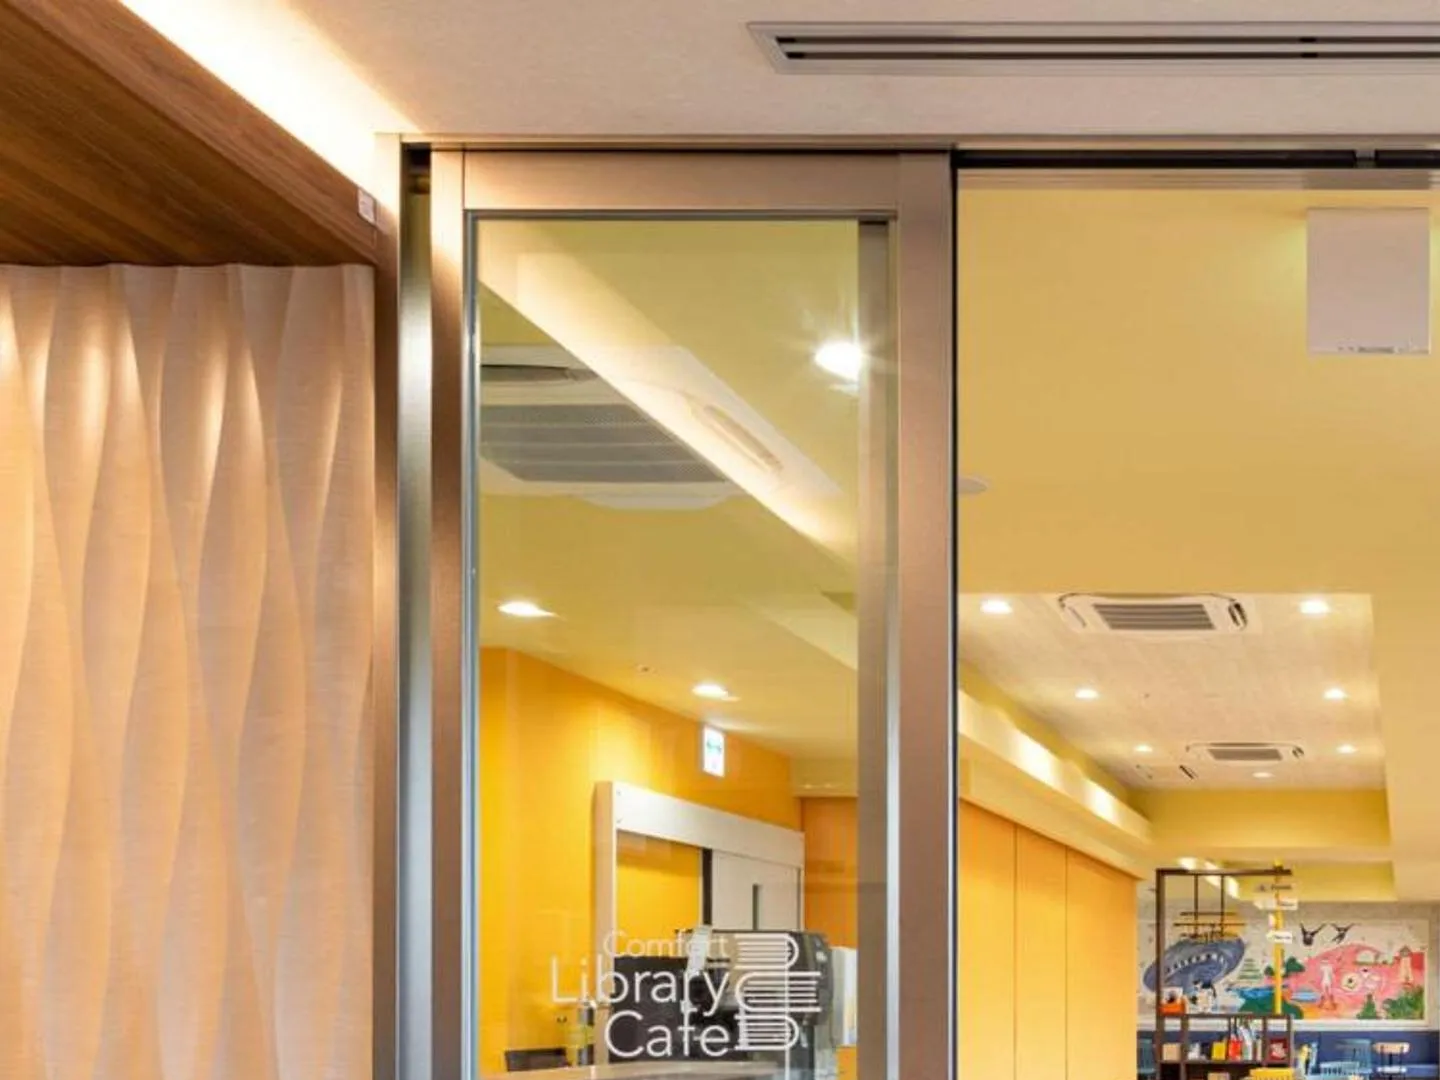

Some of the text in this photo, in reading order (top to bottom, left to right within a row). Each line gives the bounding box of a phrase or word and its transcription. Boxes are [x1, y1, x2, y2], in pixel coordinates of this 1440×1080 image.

[603, 931, 730, 958] Comfort
[551, 954, 730, 1016] Library
[604, 1010, 730, 1057] Cafe
